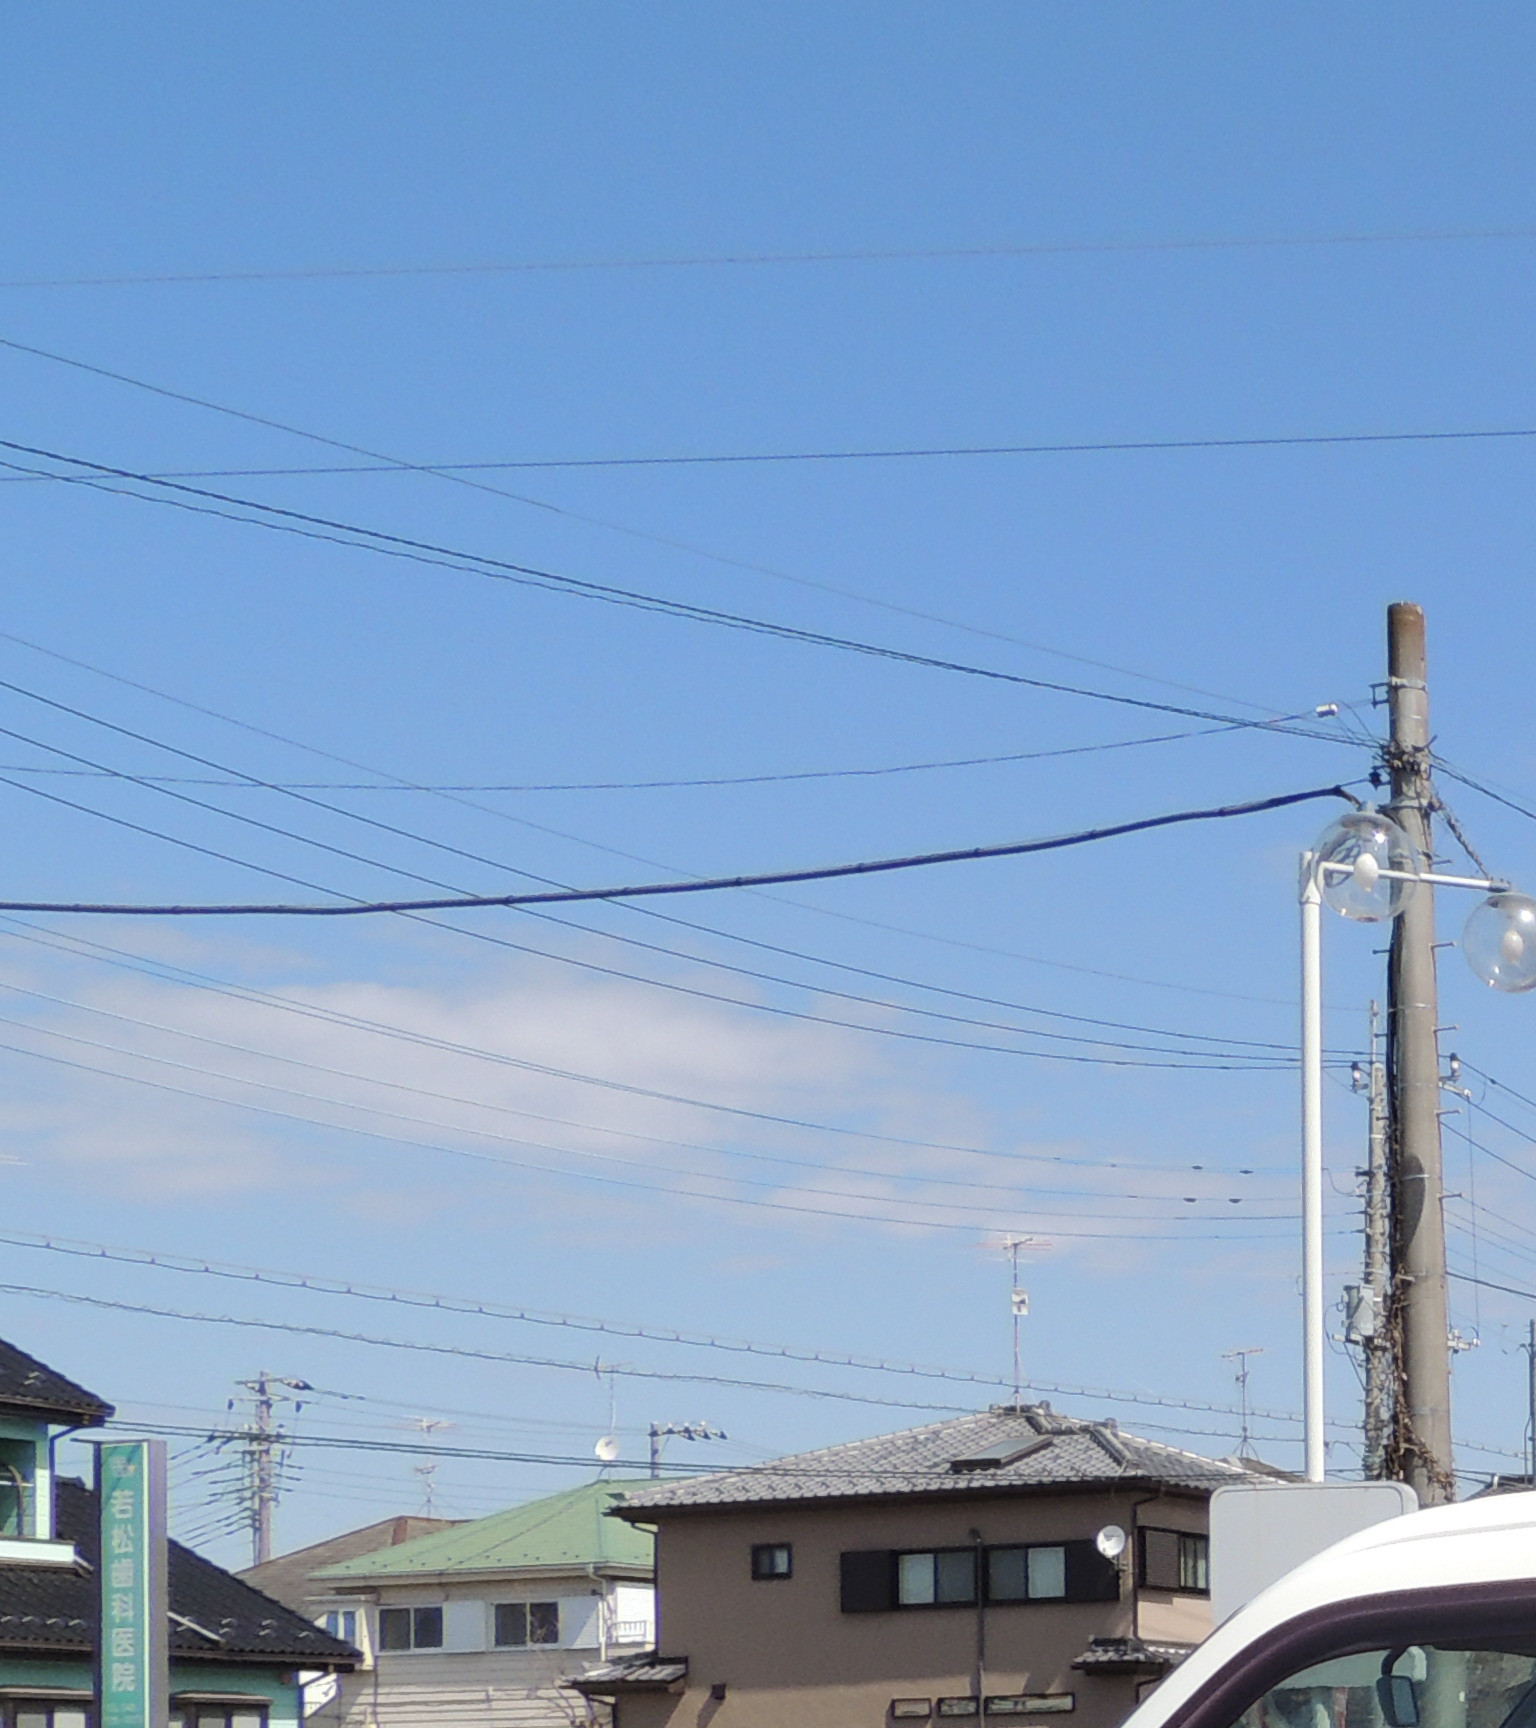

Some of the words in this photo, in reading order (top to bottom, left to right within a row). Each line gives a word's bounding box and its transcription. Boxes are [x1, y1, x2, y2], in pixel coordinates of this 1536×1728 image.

[111, 1488, 136, 1692] 若松歯科医院
